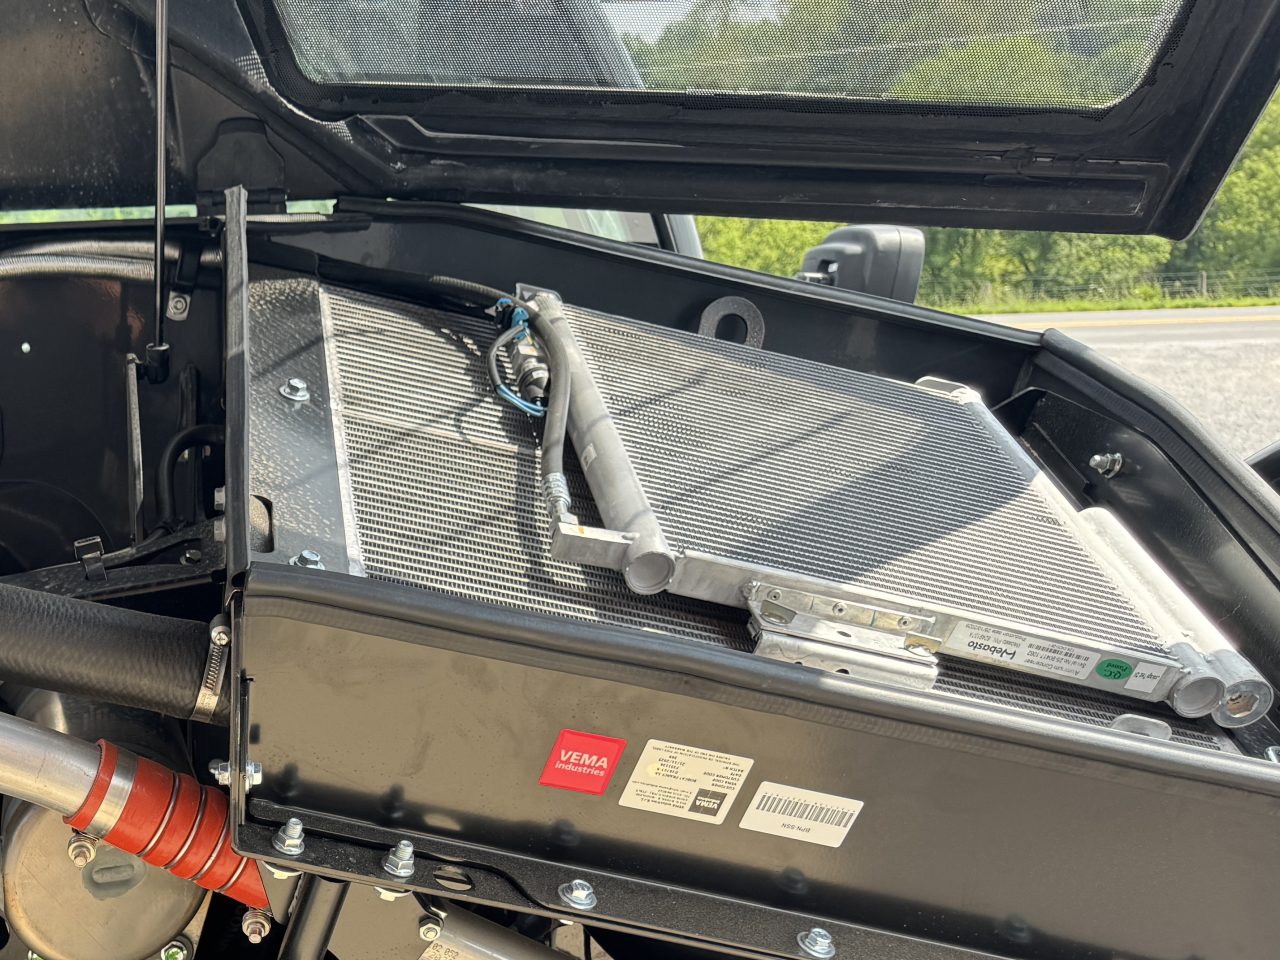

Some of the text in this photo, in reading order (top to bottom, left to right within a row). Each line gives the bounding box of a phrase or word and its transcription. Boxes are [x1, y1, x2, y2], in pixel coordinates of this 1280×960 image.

[967, 639, 1016, 660] Webasto
[555, 760, 605, 777] industries
[560, 749, 608, 769] VEMA
